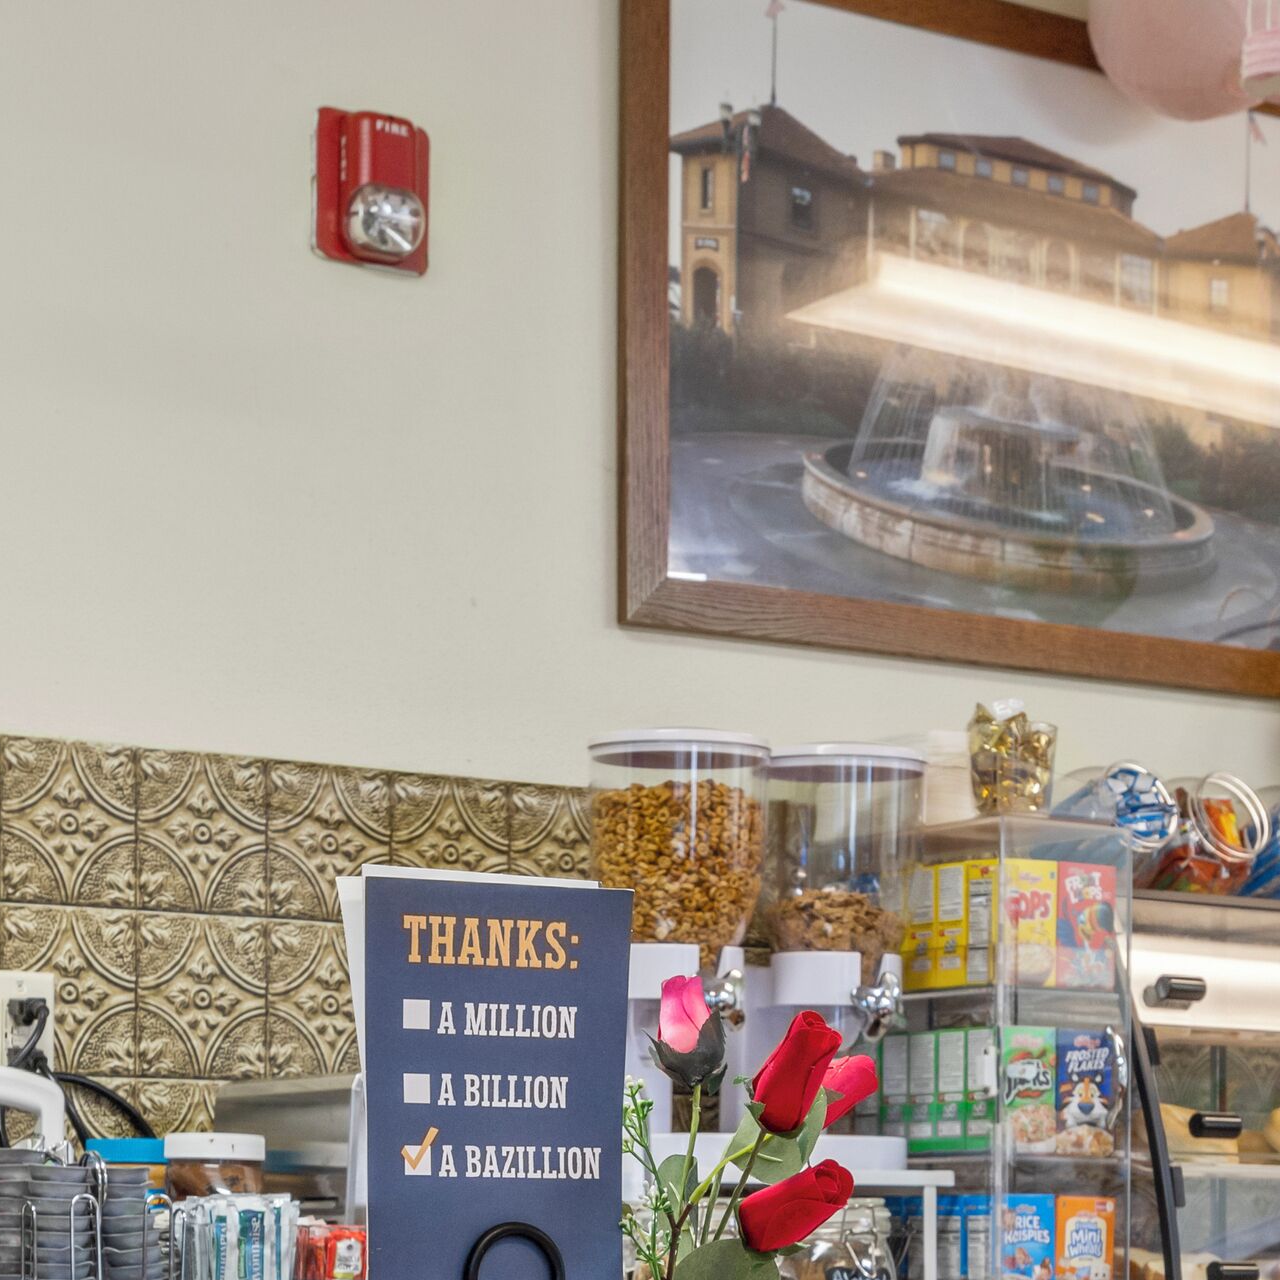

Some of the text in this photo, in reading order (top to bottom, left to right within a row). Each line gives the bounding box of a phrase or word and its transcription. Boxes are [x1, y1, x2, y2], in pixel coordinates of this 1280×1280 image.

[375, 119, 410, 137] FIRE
[403, 914, 579, 970] THANKS:
[436, 1001, 578, 1039] A MILLION
[437, 1072, 569, 1109] A BILLION
[438, 1144, 602, 1180] A BAZILLION
[1015, 1215, 1040, 1229] RICE
